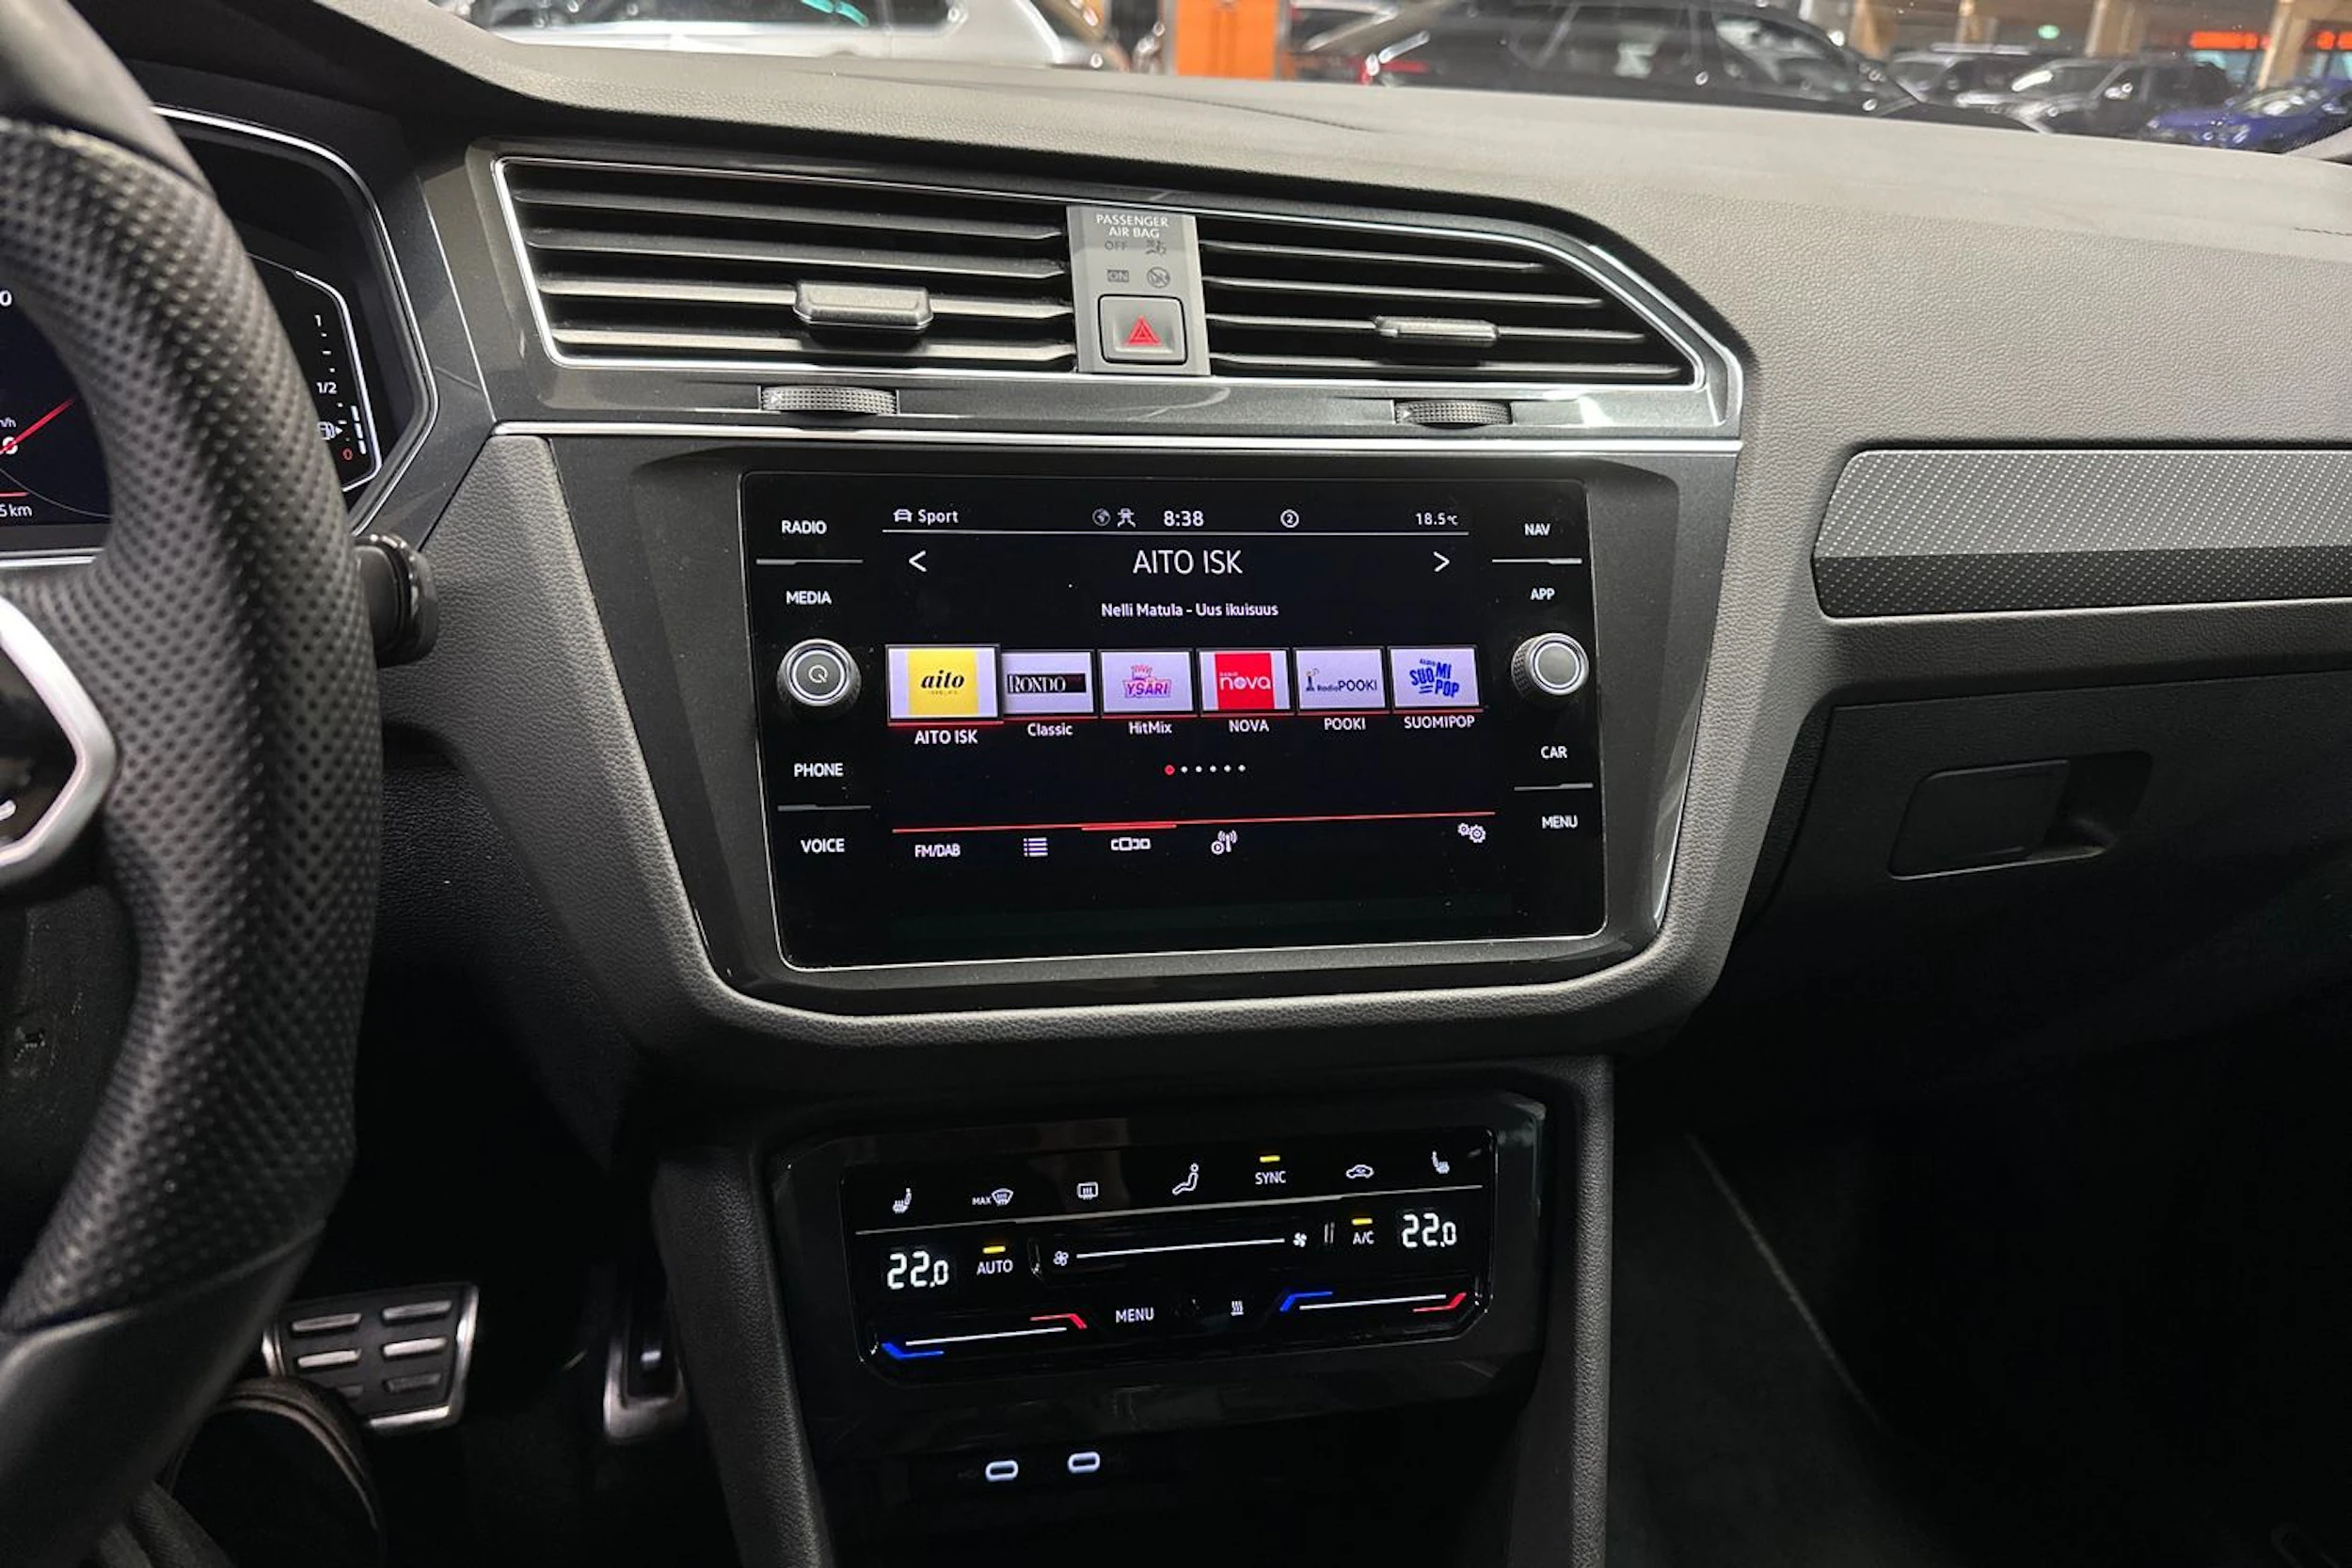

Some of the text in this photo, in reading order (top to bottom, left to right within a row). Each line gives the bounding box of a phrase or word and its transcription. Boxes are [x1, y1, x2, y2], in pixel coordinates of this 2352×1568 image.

[1095, 214, 1168, 227] PASSENGER
[1108, 227, 1160, 238] AIR BAG
[1104, 240, 1128, 251] OFF
[314, 314, 322, 327] 1
[316, 382, 338, 394] 1/2
[342, 448, 353, 460] 0
[917, 508, 959, 526] Sport
[1163, 510, 1204, 527] 8:38
[781, 519, 828, 535] RADIO
[1524, 523, 1551, 536] NAV
[1132, 549, 1244, 575] AITO ISK
[786, 590, 833, 605] MEDIA
[1530, 587, 1555, 601] APP
[1101, 602, 1134, 618] Nelli
[1136, 602, 1184, 617] Matula
[1195, 602, 1223, 617] Uus
[1225, 602, 1279, 616] ikuisuus
[921, 669, 965, 689] aito
[1009, 673, 1067, 693] RONDO
[1219, 675, 1272, 690] nova
[1127, 679, 1168, 696] YSÄRI
[1435, 679, 1460, 698] POP
[1026, 721, 1073, 737] Classic
[1128, 721, 1173, 735] HitMix
[1228, 719, 1270, 733] NOVA
[1324, 717, 1366, 731] POOKI
[1404, 714, 1475, 729] SUOMIPOP
[914, 728, 978, 745] AITO ISK
[1540, 745, 1568, 759] CAR
[793, 762, 844, 778] PHONE
[1541, 815, 1579, 830] MENU
[800, 837, 845, 854] VOICE
[914, 843, 961, 858] FM/DAB
[1254, 1170, 1287, 1185] SYNC
[972, 1196, 992, 1207] MAX
[1352, 1229, 1375, 1245] A/C
[1401, 1212, 1457, 1248] 22.0
[886, 1250, 949, 1291] 22.0
[976, 1259, 1014, 1275] AUTO
[1115, 1307, 1155, 1323] MENU
